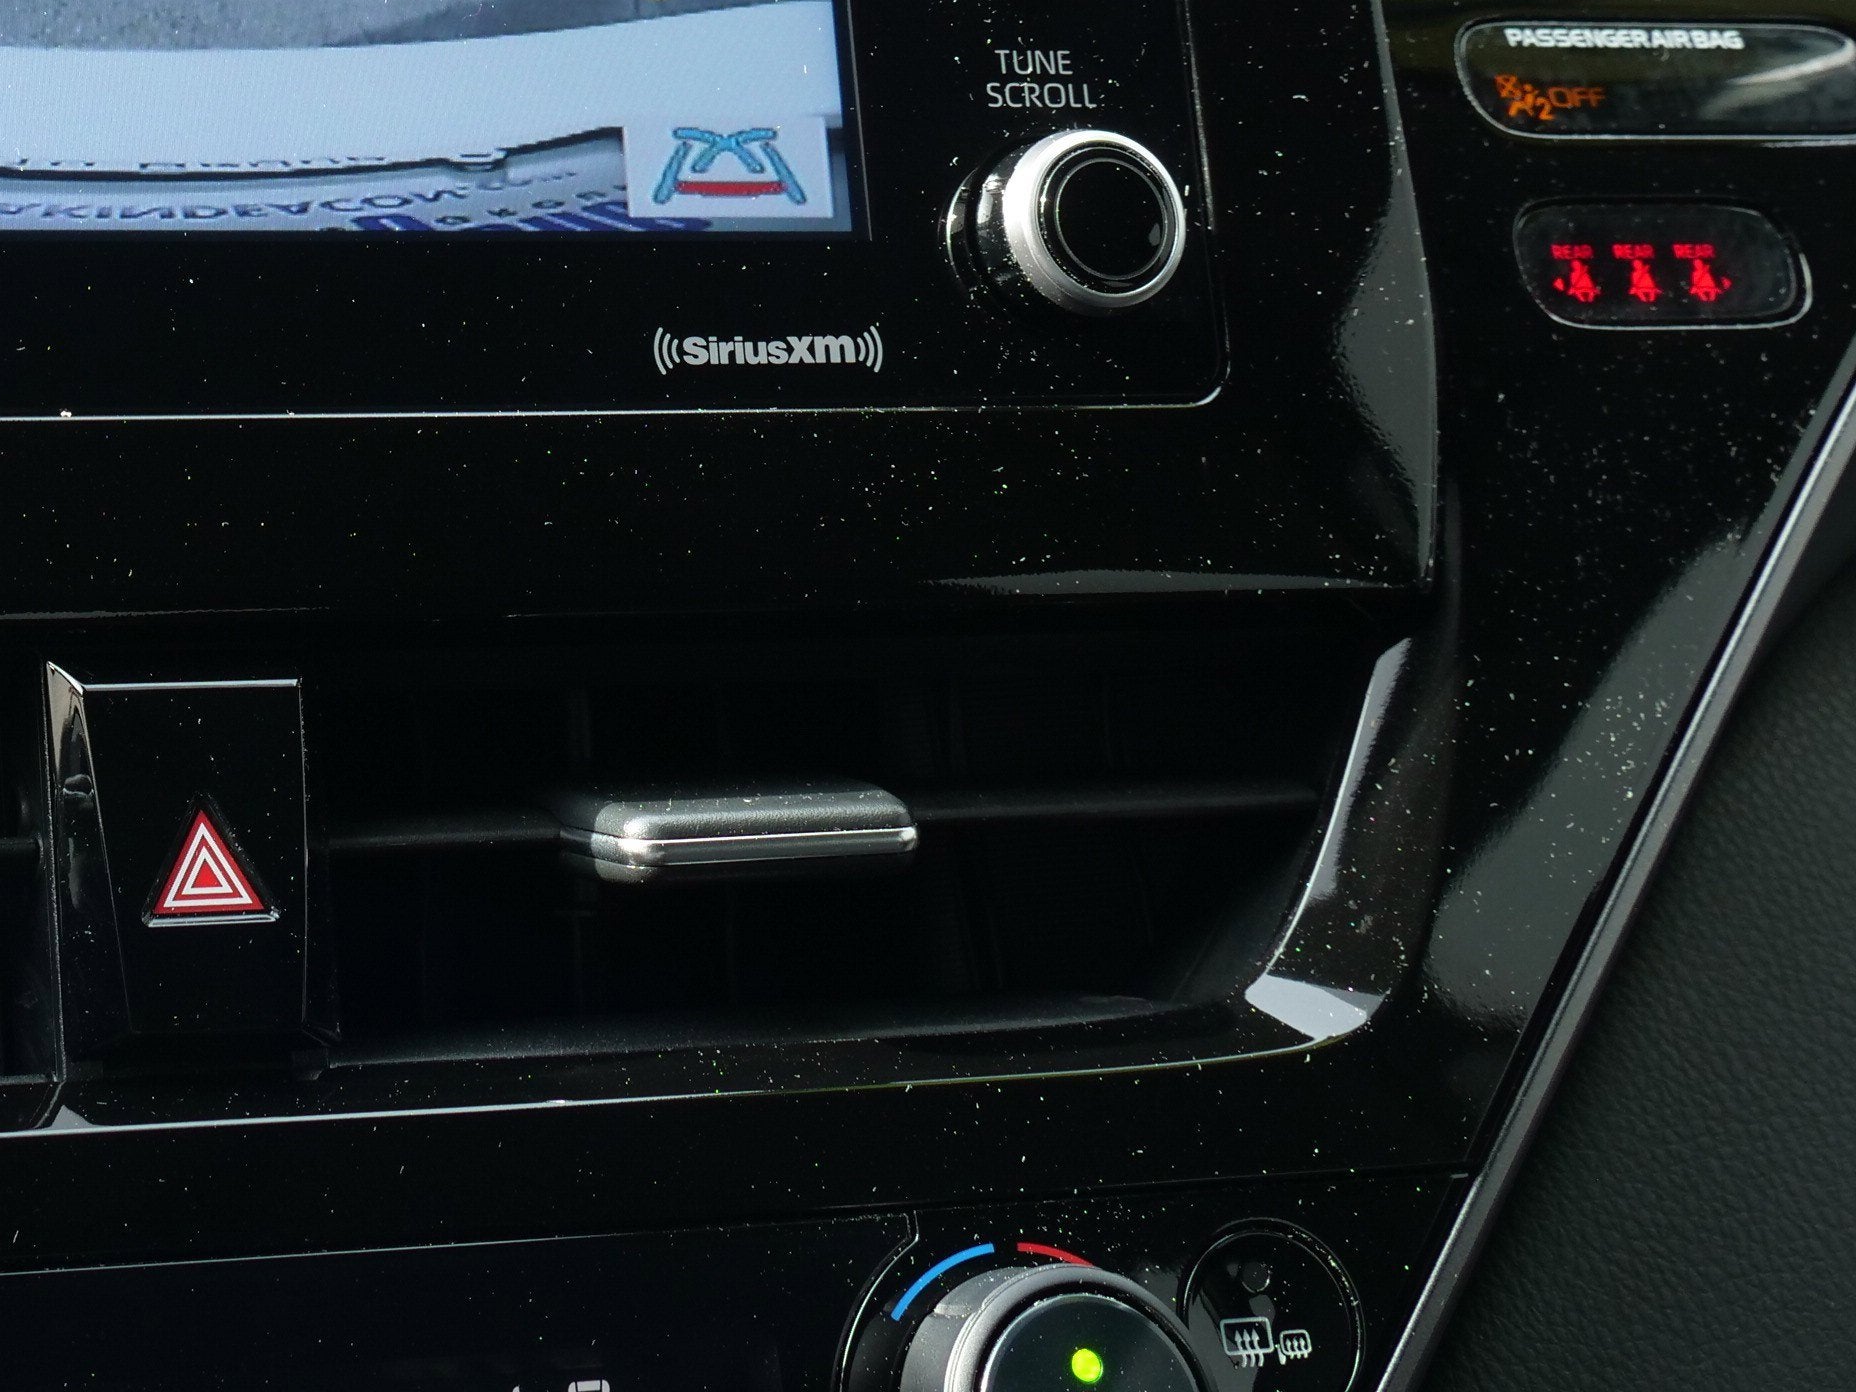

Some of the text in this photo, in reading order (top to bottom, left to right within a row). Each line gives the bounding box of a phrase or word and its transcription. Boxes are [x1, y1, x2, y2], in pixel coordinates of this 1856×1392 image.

[1503, 27, 1652, 48] PASSENGER
[994, 49, 1074, 76] TUNE
[985, 82, 1098, 109] SCROLL
[1547, 85, 1607, 109] OFF
[1551, 243, 1716, 260] REAR REAR REAR
